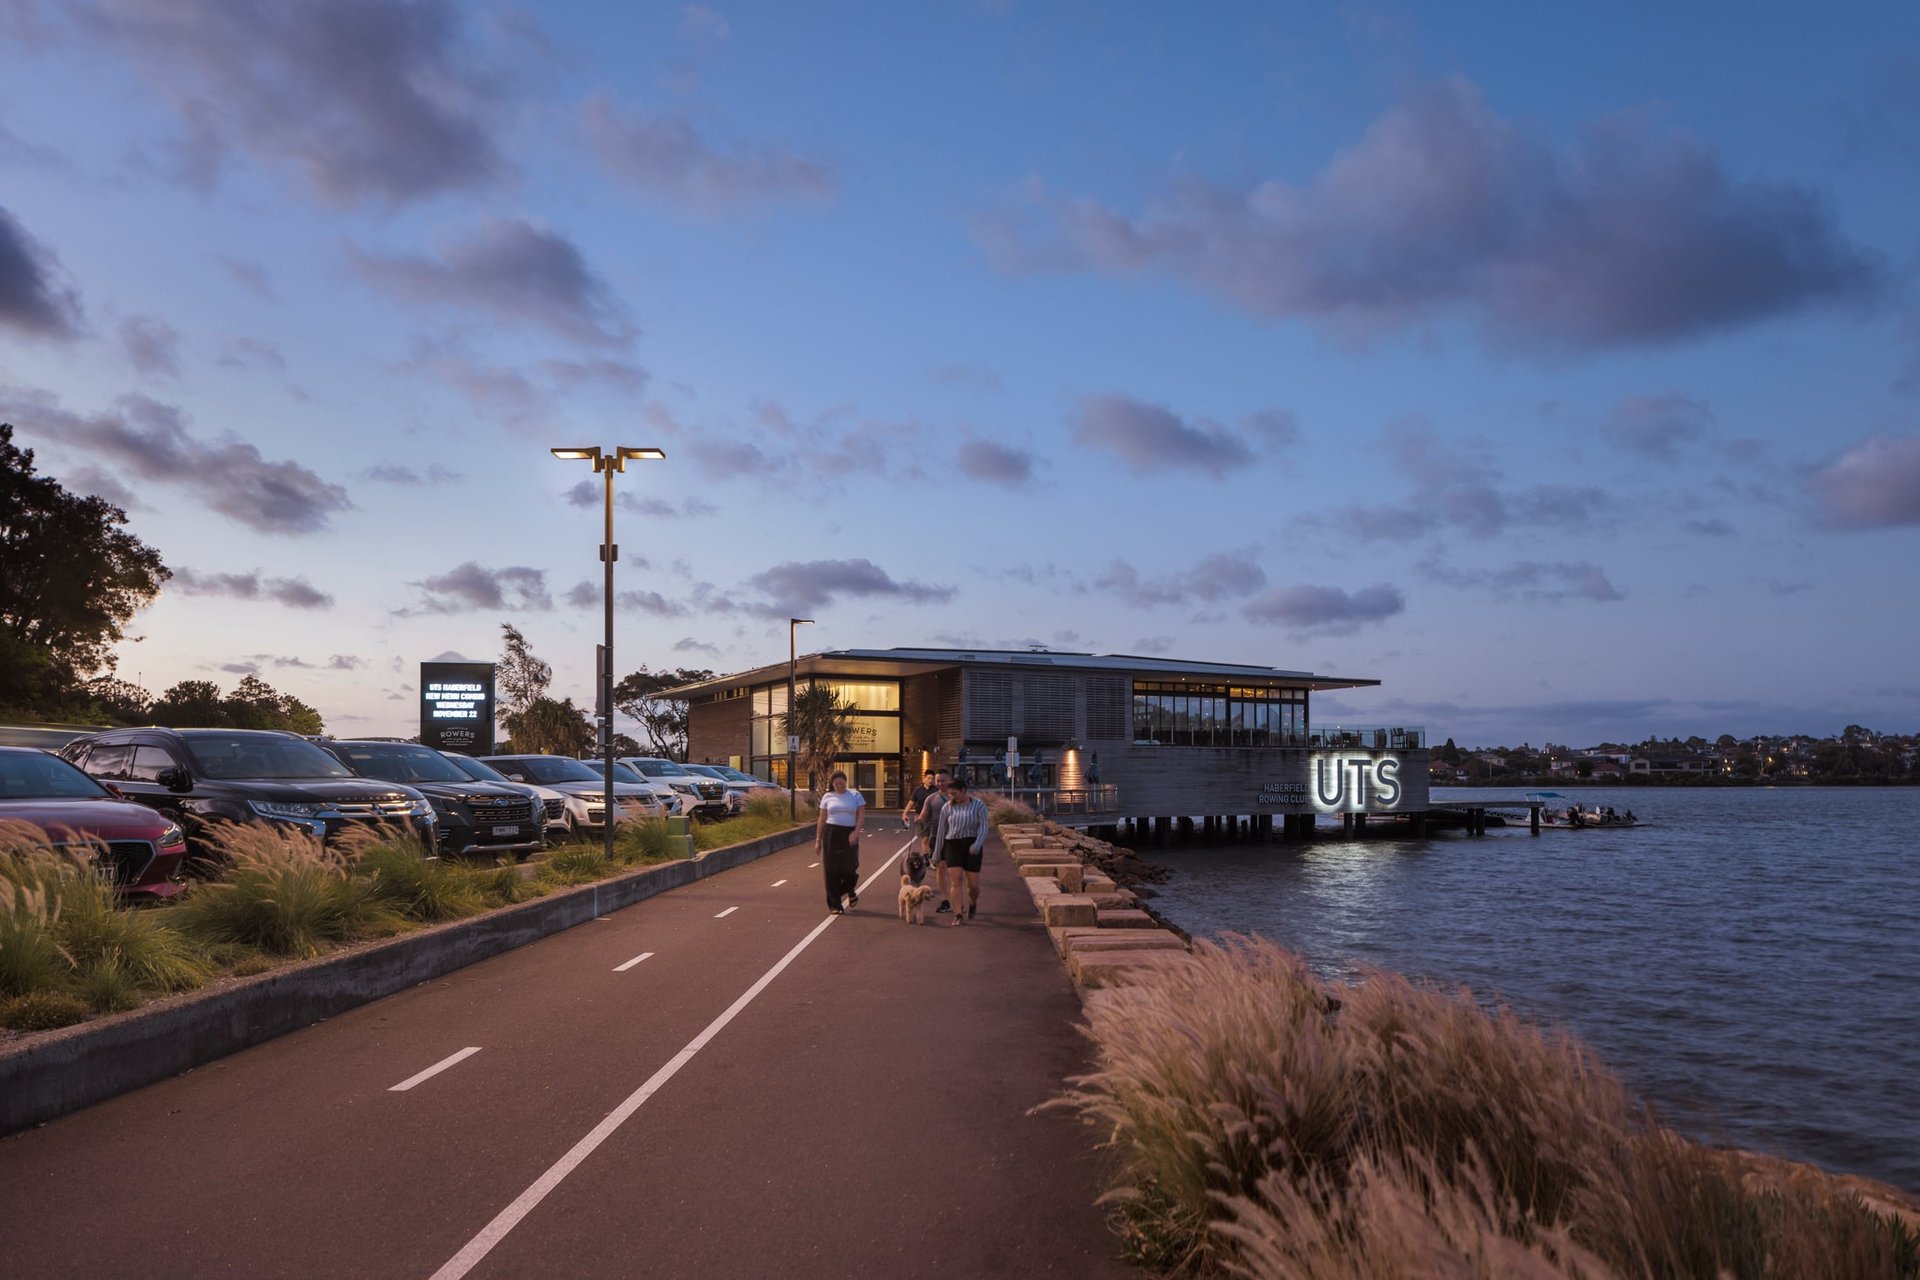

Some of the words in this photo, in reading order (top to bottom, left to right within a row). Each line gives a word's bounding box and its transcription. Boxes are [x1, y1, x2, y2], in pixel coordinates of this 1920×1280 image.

[440, 730, 475, 738] ROWERS
[1318, 759, 1400, 805] UTS
[1264, 783, 1309, 792] HABERFIELD
[1259, 794, 1289, 804] ROWING
